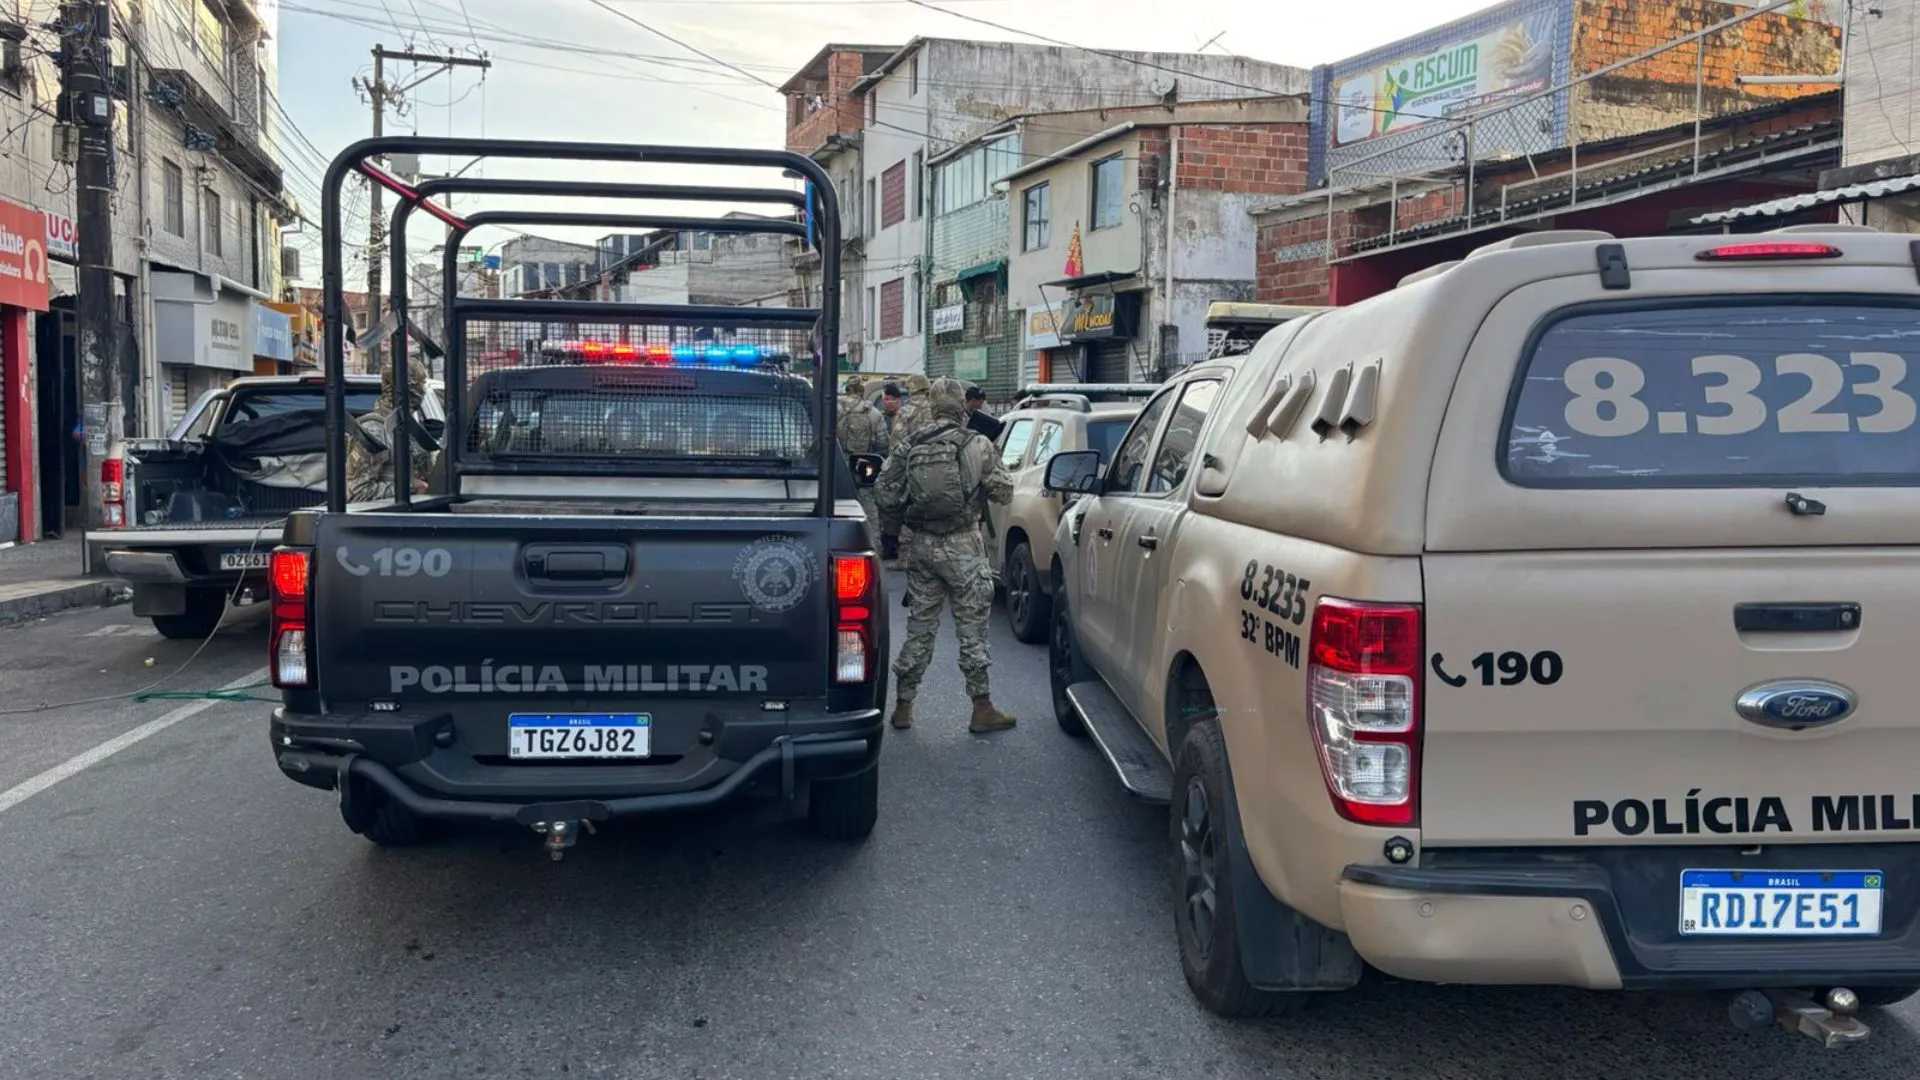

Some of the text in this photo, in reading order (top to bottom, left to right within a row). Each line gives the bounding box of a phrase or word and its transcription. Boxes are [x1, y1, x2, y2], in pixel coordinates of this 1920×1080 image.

[1414, 44, 1478, 89] ASCUM
[1564, 351, 1917, 437] 8.323
[373, 548, 452, 577] 190
[1241, 559, 1310, 625] 8.3235
[374, 601, 760, 624] CHEVROLET
[1264, 621, 1300, 670] BPM
[389, 658, 768, 693] POLÍCIA MILITAR
[1471, 650, 1563, 687] 190
[1782, 695, 1832, 717] Ford
[524, 729, 636, 752] TGZ6J82
[1573, 788, 1794, 836] POLÍCIA
[1768, 878, 1800, 886] BRASIL
[1684, 919, 1696, 931] BR
[1701, 893, 1860, 928] RDI7E51
